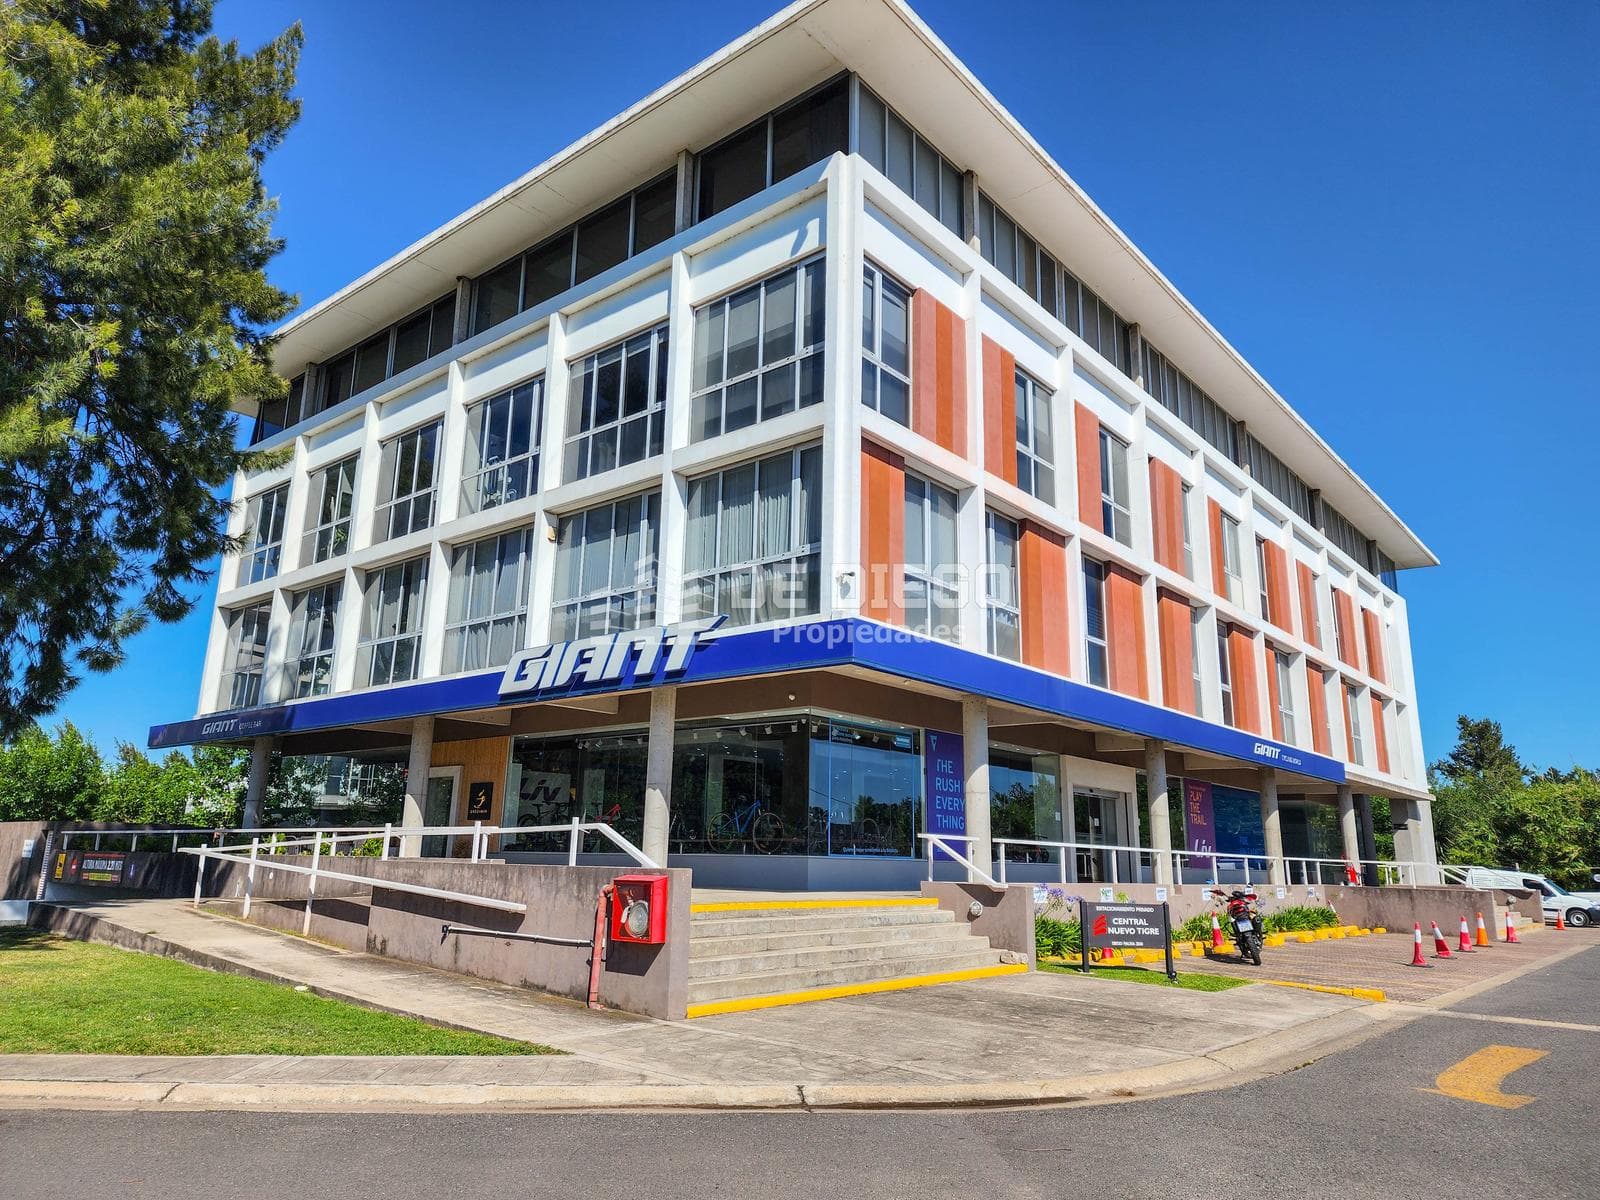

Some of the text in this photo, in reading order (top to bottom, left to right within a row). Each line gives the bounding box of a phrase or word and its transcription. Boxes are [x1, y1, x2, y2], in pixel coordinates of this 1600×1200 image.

[498, 614, 729, 695] GIANT
[202, 719, 239, 735] GIANT
[1254, 743, 1281, 759] GIANT
[936, 759, 953, 774] THE
[936, 778, 961, 793] RUSH
[936, 796, 965, 811] EVERY
[1190, 790, 1202, 802] PLAY
[1190, 802, 1201, 813] THE
[936, 814, 965, 830] THING
[1113, 918, 1149, 926] CENTRAL
[1108, 927, 1136, 935] NUEVO
